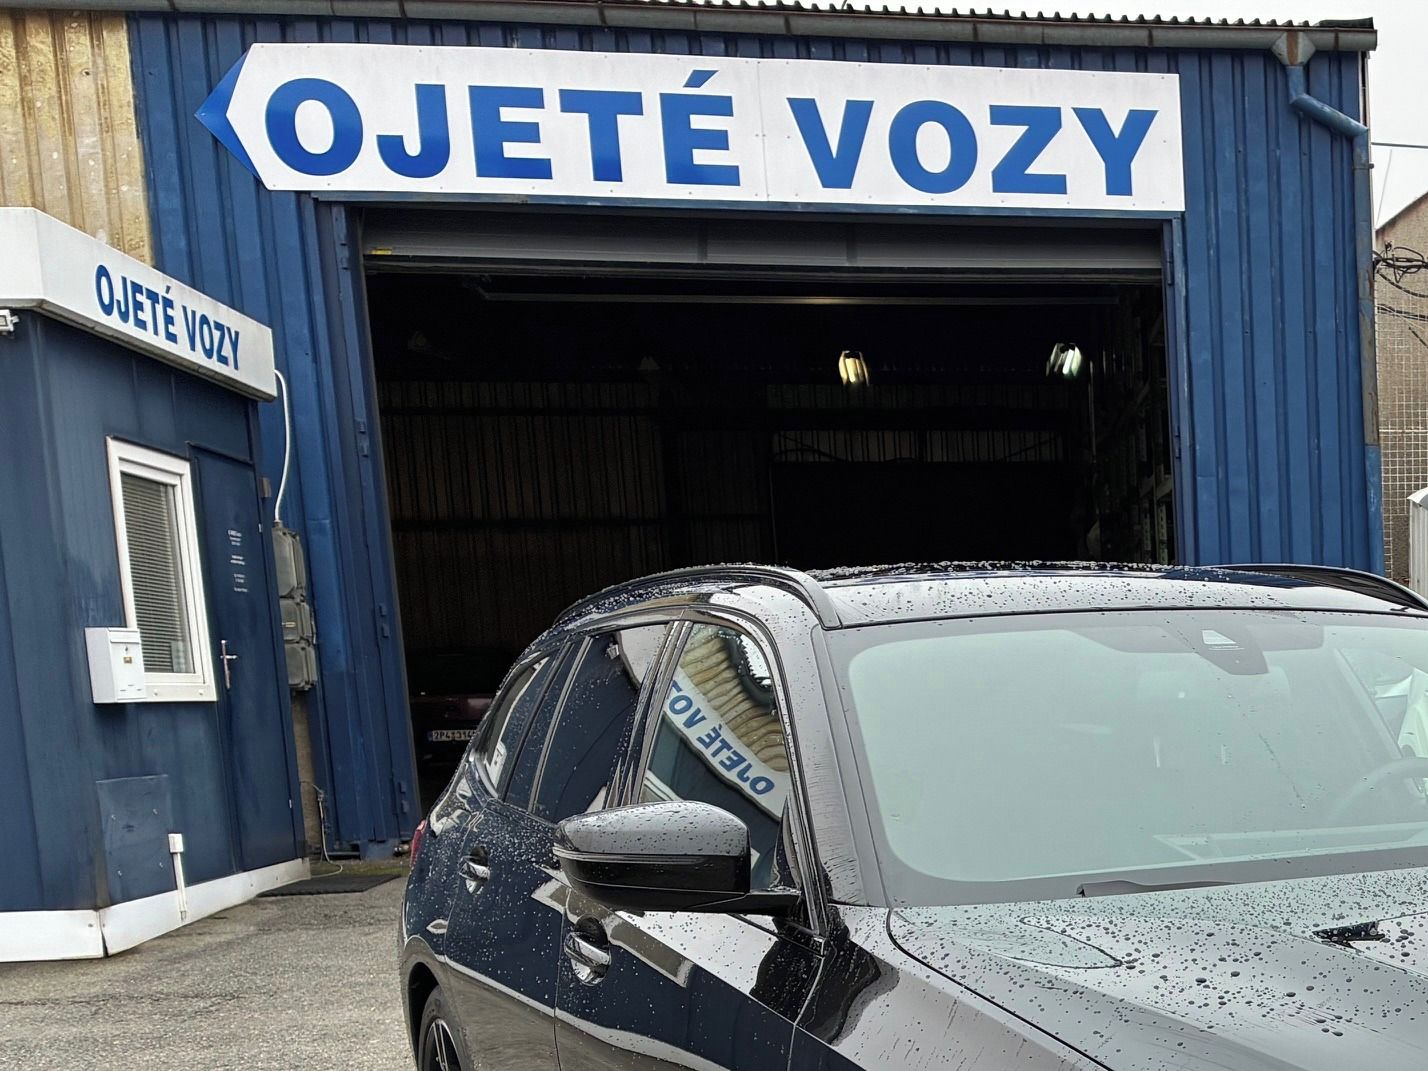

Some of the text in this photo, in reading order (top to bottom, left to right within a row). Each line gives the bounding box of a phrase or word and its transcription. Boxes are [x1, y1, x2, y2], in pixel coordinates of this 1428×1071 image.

[265, 69, 1158, 196] OJETÉ VOZY
[95, 264, 240, 371] OJETÉ VOZY
